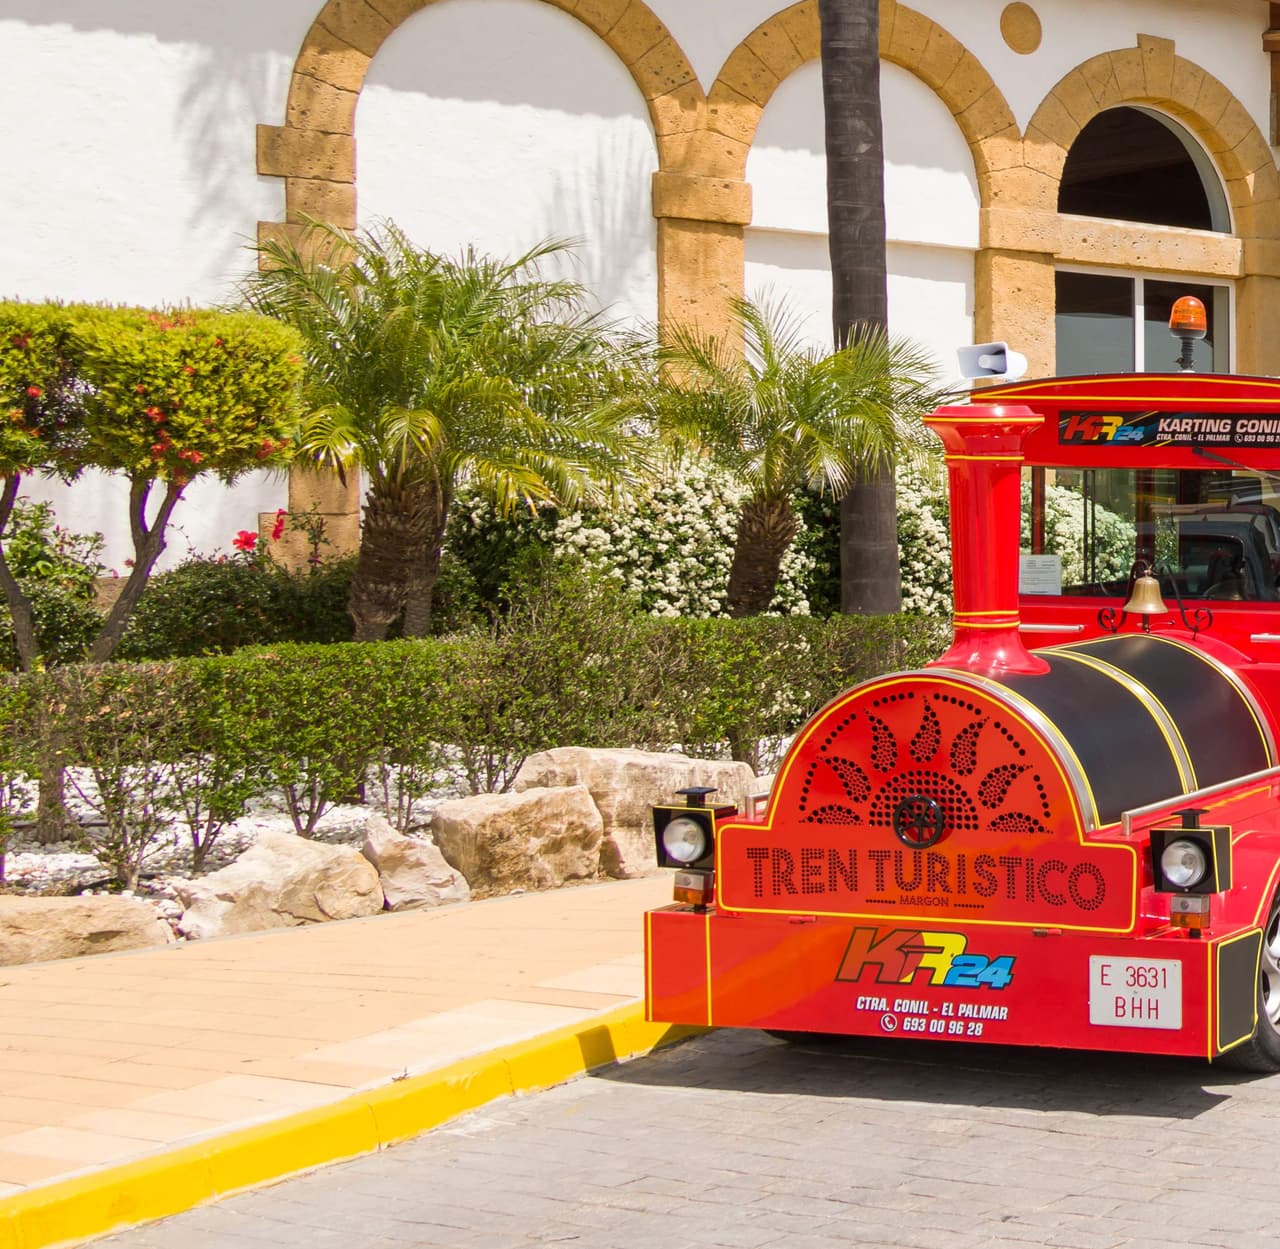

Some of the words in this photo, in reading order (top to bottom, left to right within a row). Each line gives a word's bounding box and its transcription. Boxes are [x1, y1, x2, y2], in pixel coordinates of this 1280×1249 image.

[1158, 418, 1232, 433] KARTING
[1174, 433, 1193, 441] CONIL
[1206, 434, 1230, 442] PALMAR
[746, 847, 859, 898] TREN
[868, 848, 1106, 912] TURISTICO
[899, 895, 949, 907] MARGON
[1100, 964, 1112, 986] E
[1125, 966, 1167, 989] 3631
[856, 995, 890, 1012] CTRA.
[893, 998, 929, 1015] CONIL
[941, 1002, 954, 1017] EL
[957, 1004, 1009, 1021] PALMAR
[1115, 996, 1159, 1020] BHH
[902, 1017, 926, 1032] 693
[929, 1018, 945, 1034] 00
[948, 1020, 964, 1035] 96
[966, 1022, 983, 1036] 28
